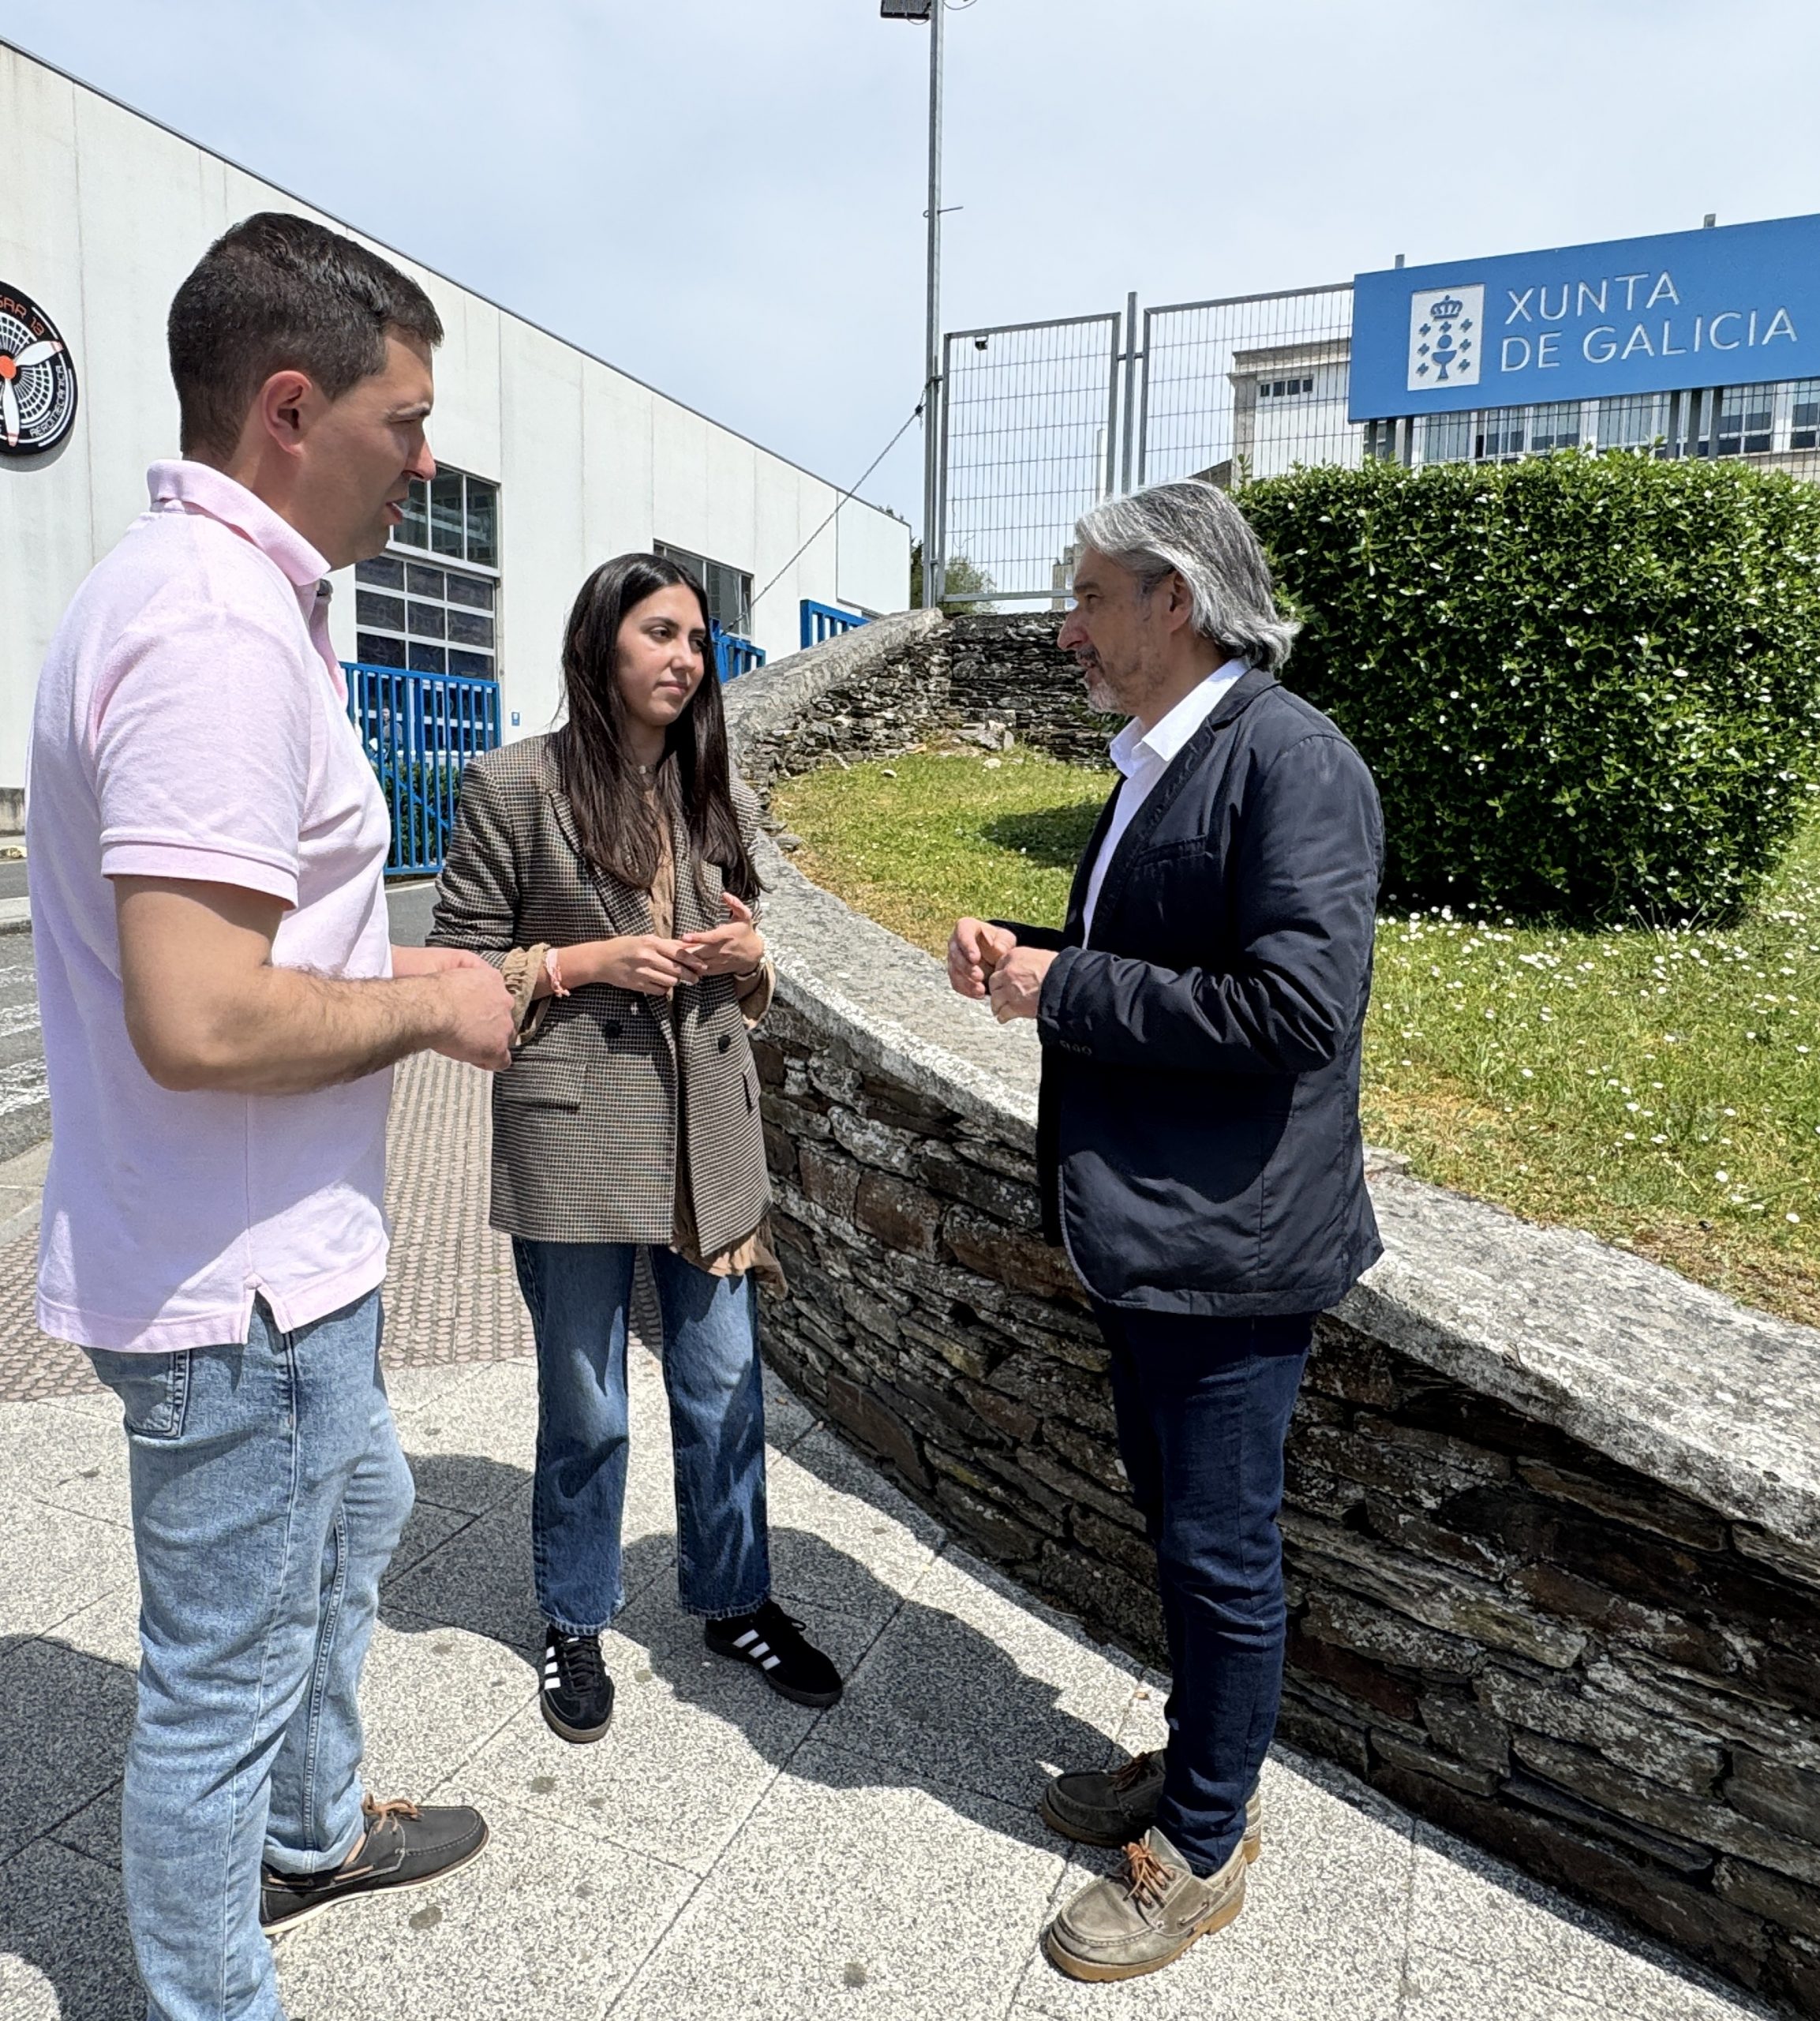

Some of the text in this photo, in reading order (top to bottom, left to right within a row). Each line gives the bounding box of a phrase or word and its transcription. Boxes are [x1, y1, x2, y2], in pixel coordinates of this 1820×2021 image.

[1505, 271, 1680, 324] XUNTA
[1501, 306, 1798, 373] DE GALICIA
